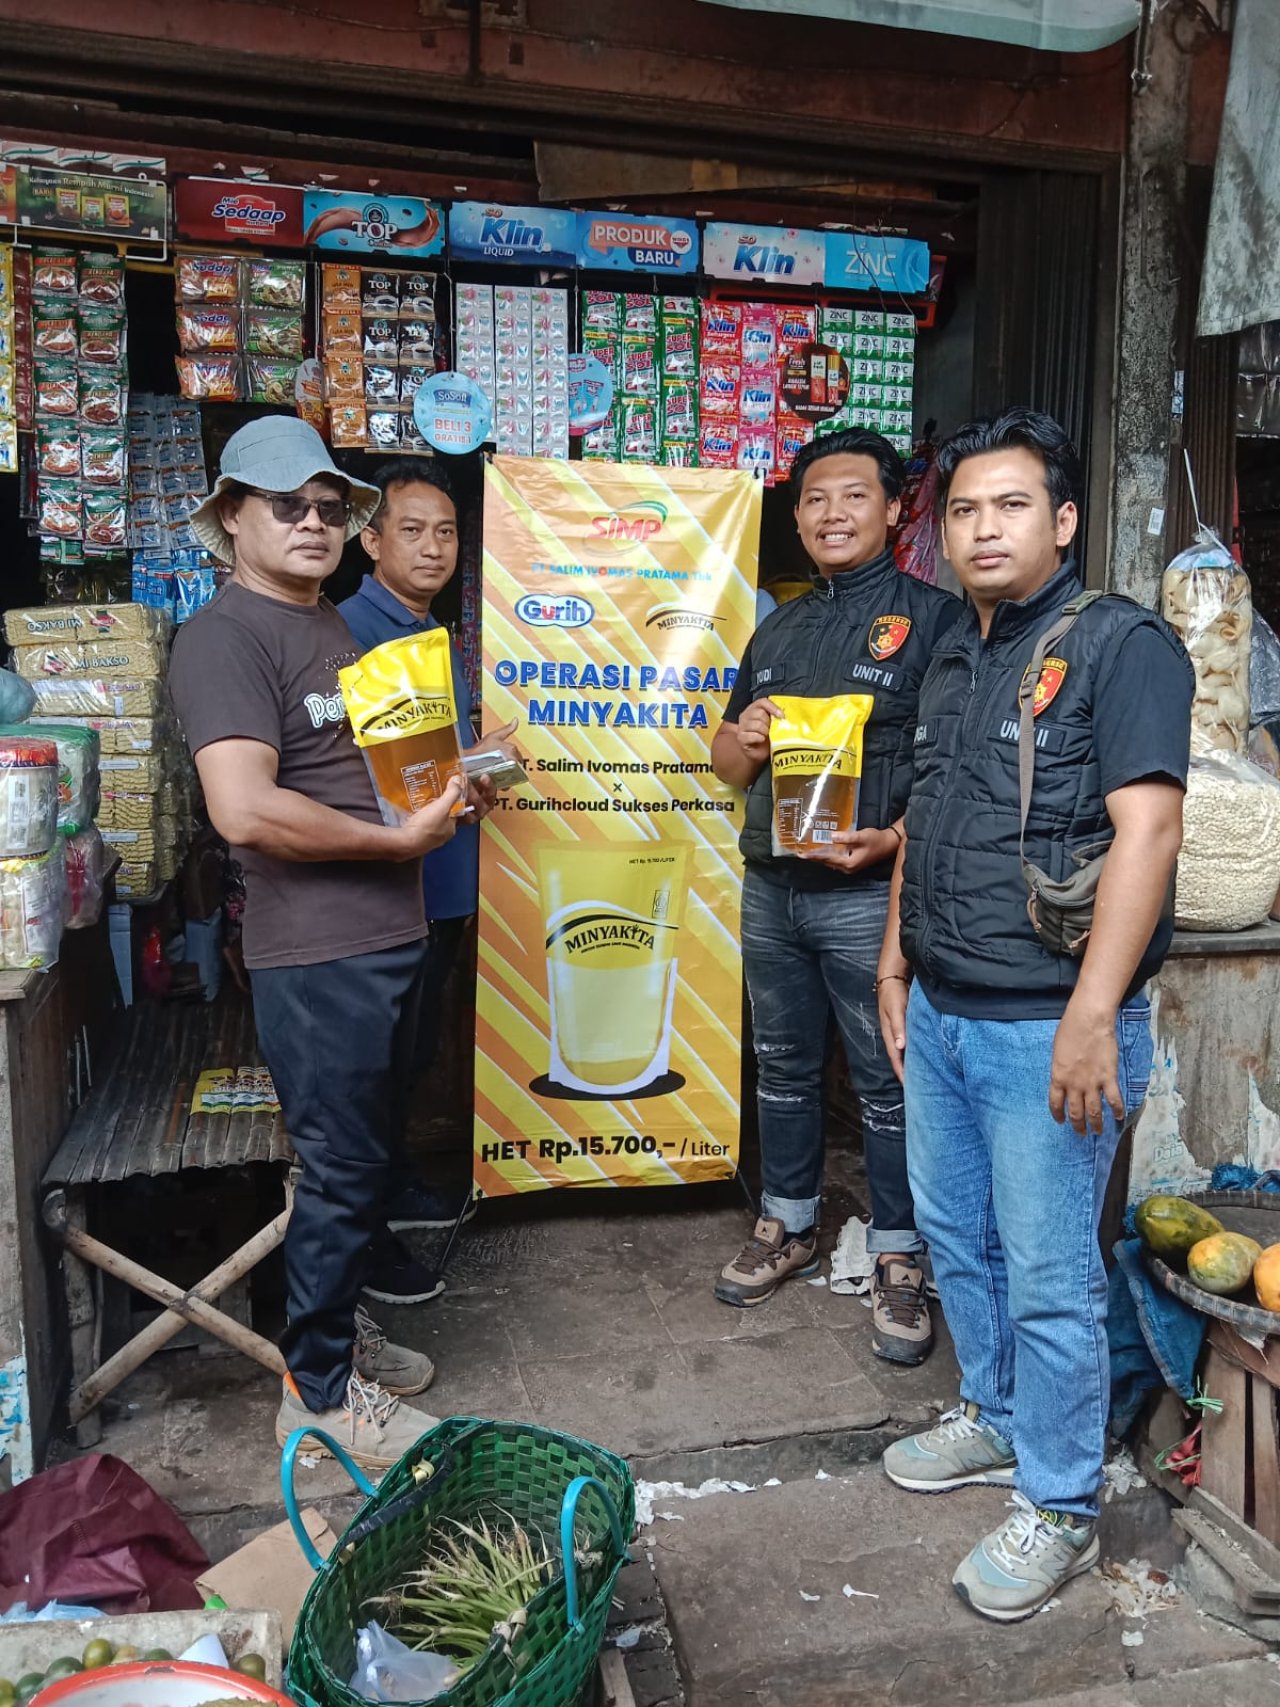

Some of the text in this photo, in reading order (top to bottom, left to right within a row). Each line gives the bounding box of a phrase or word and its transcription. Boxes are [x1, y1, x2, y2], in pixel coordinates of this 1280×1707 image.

[212, 204, 286, 225] Sedaap
[351, 220, 398, 240] TOP
[479, 217, 544, 248] Klin
[594, 225, 667, 247] PRODUK
[484, 247, 514, 257] LIQUID
[635, 250, 674, 265] BARU
[733, 244, 797, 275] Klin
[844, 251, 898, 277] ZINC
[368, 280, 392, 290] TOP
[406, 281, 430, 291] TOP
[829, 310, 847, 319] ZINC
[861, 313, 879, 323] ZINC
[892, 316, 910, 325] ZINC
[368, 327, 392, 337] TOP
[434, 418, 472, 433] BELI 3
[588, 514, 662, 542] SIMP
[550, 564, 584, 575] SALIM
[637, 569, 689, 581] PRATAMA
[523, 599, 587, 622] Gurih
[27, 619, 65, 632] BAKSO
[657, 615, 716, 631] MINYAKITA
[92, 656, 129, 668] BAKSO
[495, 660, 740, 692] OPERASI PASAR
[852, 664, 894, 687] UNIT II
[527, 699, 709, 729] MINYAKITA
[536, 759, 584, 774] Salim
[587, 760, 650, 774] Ivomas
[516, 797, 609, 812] Gurihcloud
[612, 798, 668, 813] Sukses
[671, 799, 735, 813] Perkasa
[565, 925, 656, 954] MINYAKITA
[481, 1139, 532, 1162] HET
[691, 1140, 731, 1157] Liter
[1154, 1143, 1184, 1163] Daia
